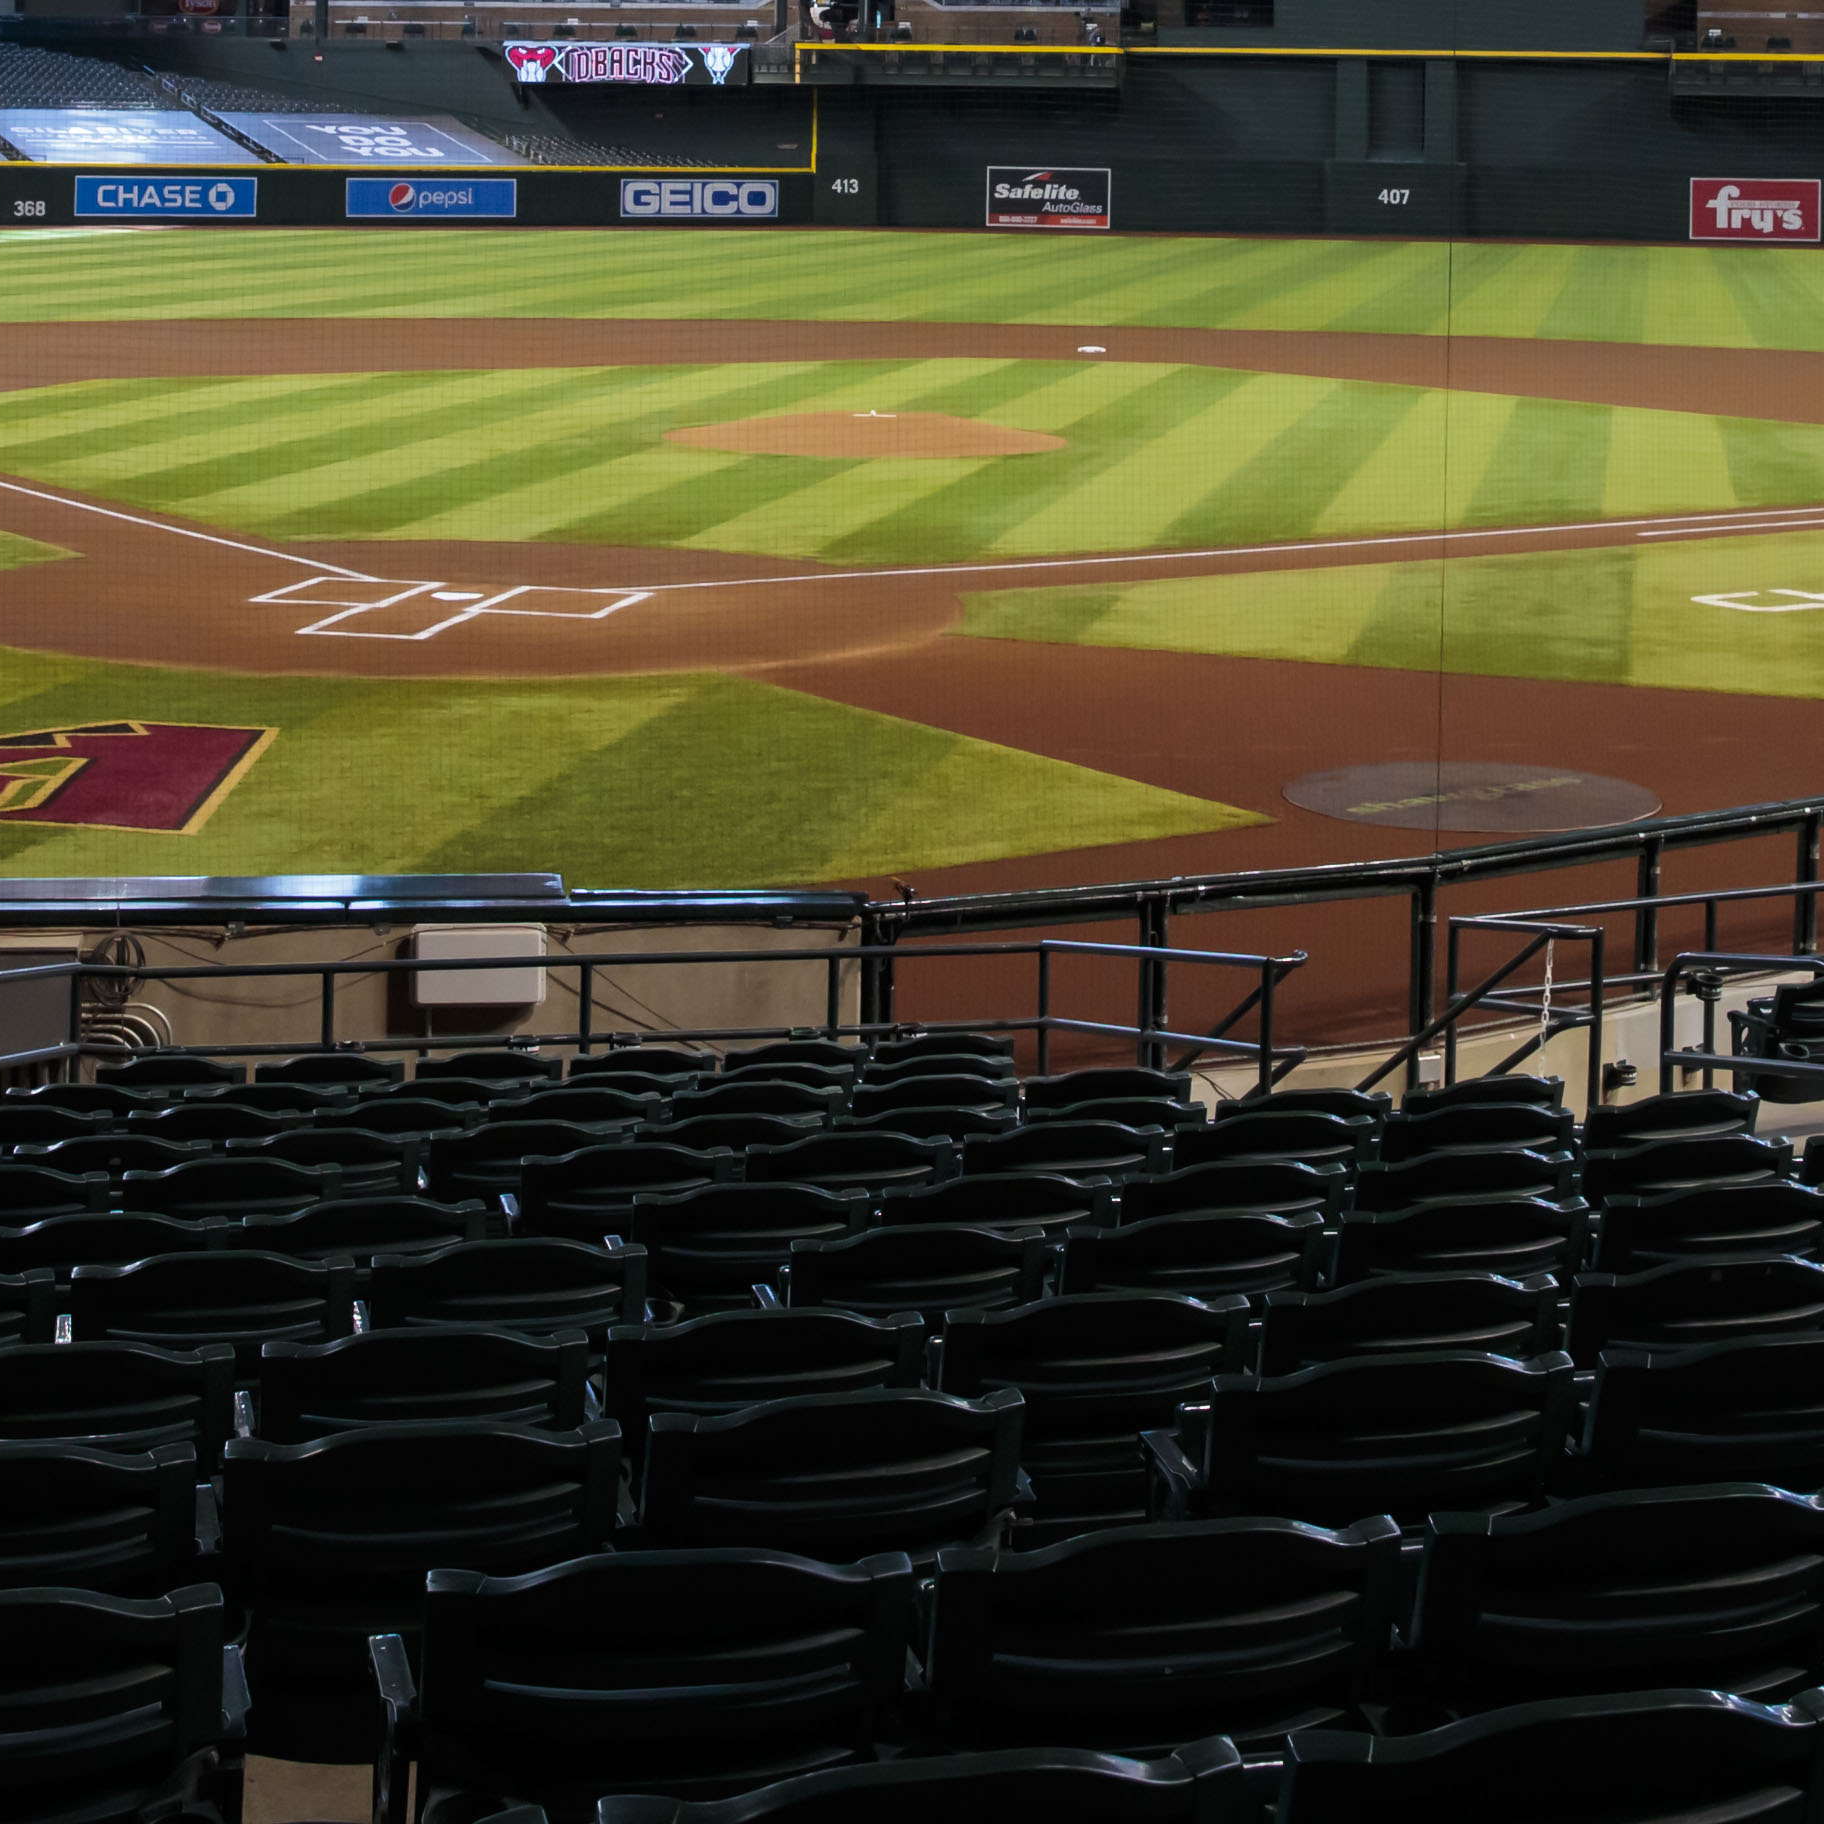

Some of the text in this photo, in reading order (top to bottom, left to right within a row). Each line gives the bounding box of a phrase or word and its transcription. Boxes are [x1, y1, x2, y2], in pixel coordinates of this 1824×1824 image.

[306, 125, 406, 135] YOU
[338, 135, 411, 147] DO
[341, 147, 445, 157] YOU
[832, 178, 859, 195] 413
[994, 183, 1080, 202] Safelite
[97, 185, 202, 209] CHASE
[420, 187, 473, 208] pepsi
[625, 182, 775, 214] GEICO
[1378, 189, 1409, 206] 407
[13, 201, 45, 217] 368
[1042, 201, 1103, 215] AutoGlass
[1706, 185, 1803, 233] fry's
